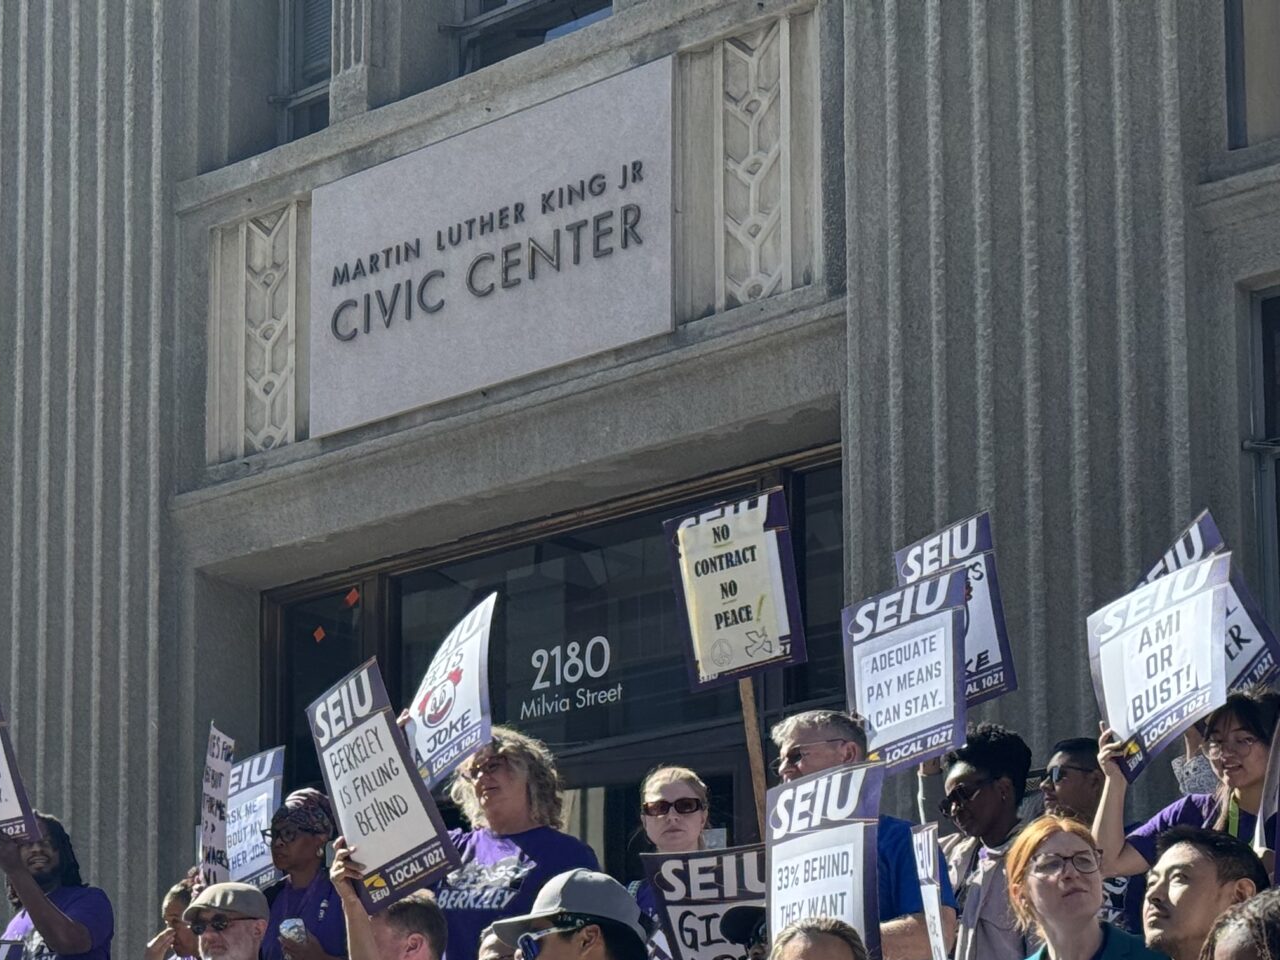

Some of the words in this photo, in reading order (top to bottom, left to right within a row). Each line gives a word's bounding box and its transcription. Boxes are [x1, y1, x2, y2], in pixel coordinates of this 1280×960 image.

[332, 238, 420, 287] MARTIN
[436, 202, 525, 251] LUTHER
[541, 174, 606, 214] KING
[618, 160, 644, 189] JR
[331, 269, 445, 342] CIVIC
[465, 204, 644, 297] CENTER
[712, 523, 731, 543] NO
[905, 517, 978, 584] SEIU
[694, 545, 757, 577] CONTRACT
[720, 580, 739, 600] NO
[853, 573, 952, 643] SEIU
[1100, 560, 1214, 643] SEIU
[1138, 610, 1181, 653] AMI
[531, 636, 611, 691] 2180
[871, 634, 937, 675] ADEQUATE
[1145, 643, 1173, 680] OR
[1253, 652, 1275, 681] 1021
[520, 693, 570, 720] Milvia
[575, 683, 623, 708] Street
[867, 681, 892, 704] PAY
[897, 661, 942, 691] MEANS
[982, 671, 1004, 691] 1021
[1130, 664, 1192, 723] BUST!
[315, 668, 373, 748] SEIU
[876, 705, 901, 729] CAN
[904, 690, 943, 716] STAY.
[1143, 712, 1180, 747] LOCAL
[1183, 694, 1210, 717] 1021
[427, 708, 472, 754] JOKE
[432, 743, 461, 774] LOCAL
[461, 728, 482, 750] 1021
[886, 739, 923, 764] LOCAL
[926, 728, 953, 748] 1021
[329, 726, 384, 781] BERKELEY
[338, 786, 353, 810] IS
[353, 757, 401, 797] FALLING
[773, 768, 867, 840] SEIU
[353, 793, 409, 838] BEHIND
[390, 862, 424, 886] LOCAL
[424, 847, 446, 868] 1021
[661, 851, 766, 901] SEIU
[777, 863, 800, 892] 33%
[803, 851, 854, 884] BEHIND,
[371, 887, 390, 904] SEIU
[780, 899, 804, 929] THEY
[807, 891, 847, 919] WANT
